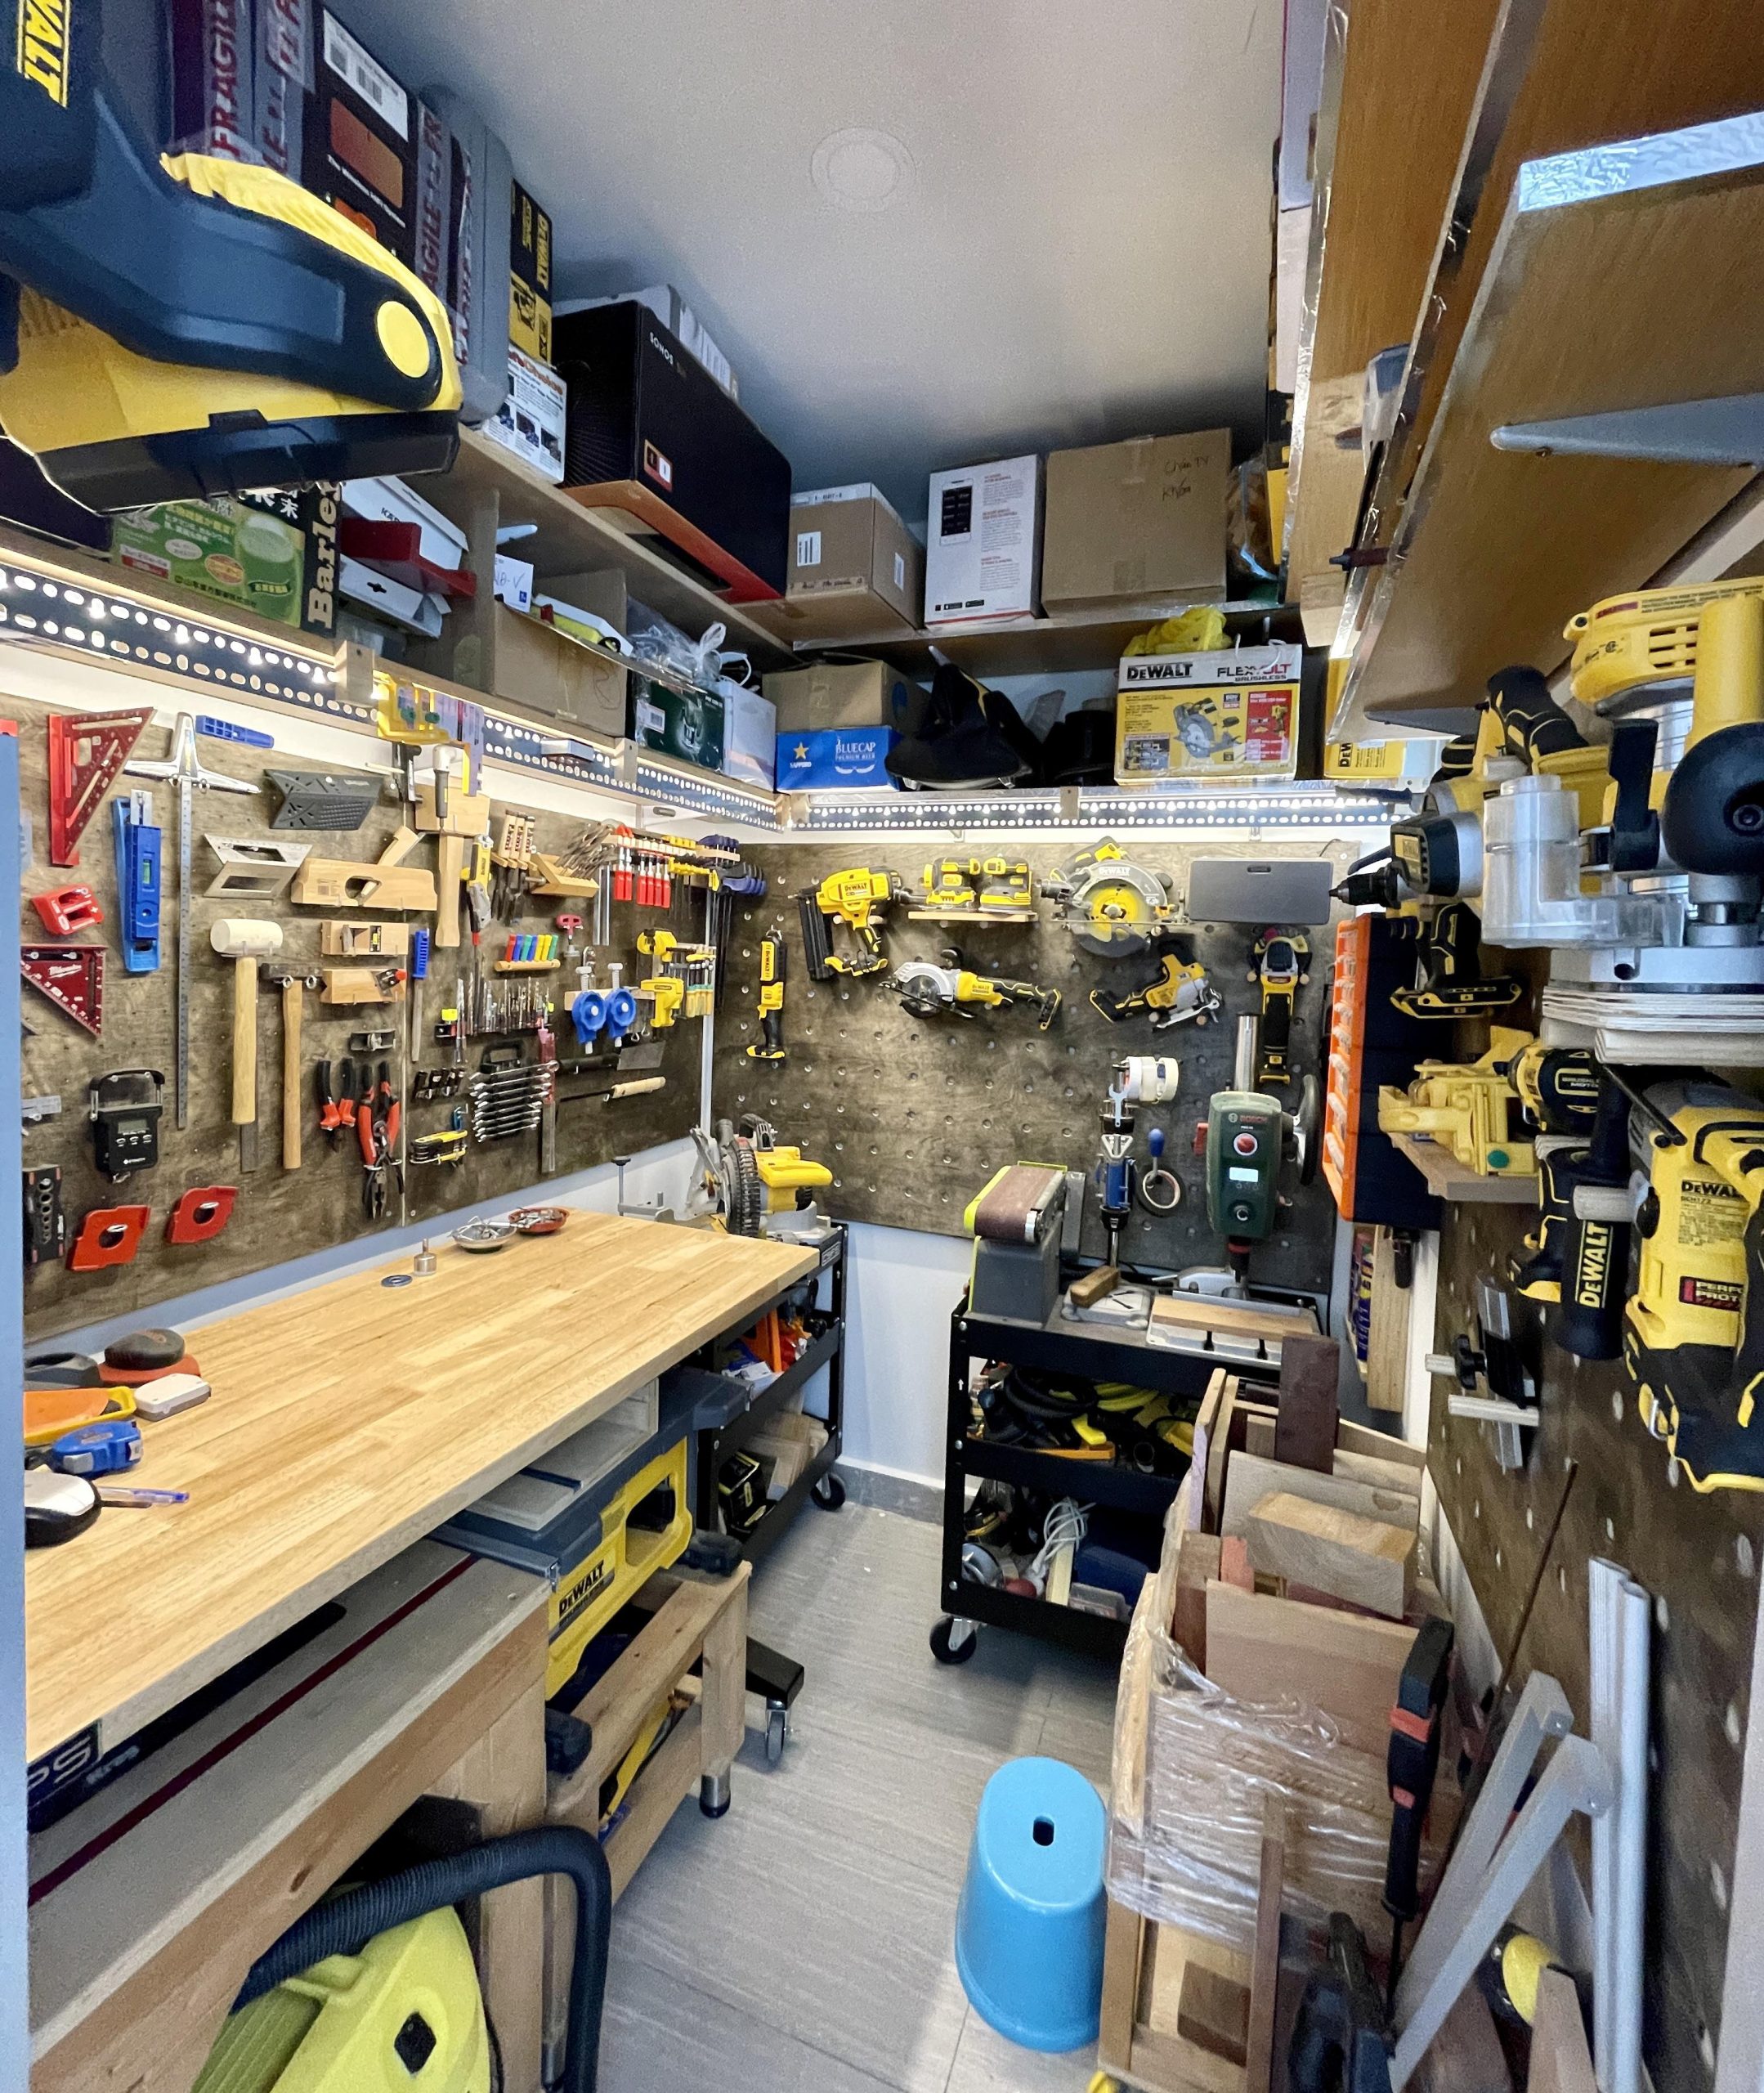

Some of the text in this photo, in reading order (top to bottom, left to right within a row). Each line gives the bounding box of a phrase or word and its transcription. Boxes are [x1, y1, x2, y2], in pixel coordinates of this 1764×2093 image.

[210, 0, 240, 158] FRAGIL
[420, 196, 441, 289] AGILE
[649, 331, 674, 366] SONOS
[1126, 664, 1193, 680] DEWALT
[835, 742, 876, 754] BLUECAP
[1099, 867, 1130, 876] DEWALT
[844, 882, 867, 892] DEWALT
[1239, 1114, 1268, 1123] BOSCH
[1681, 1181, 1744, 1202] DEWAL
[1578, 1221, 1609, 1308] DEWALT
